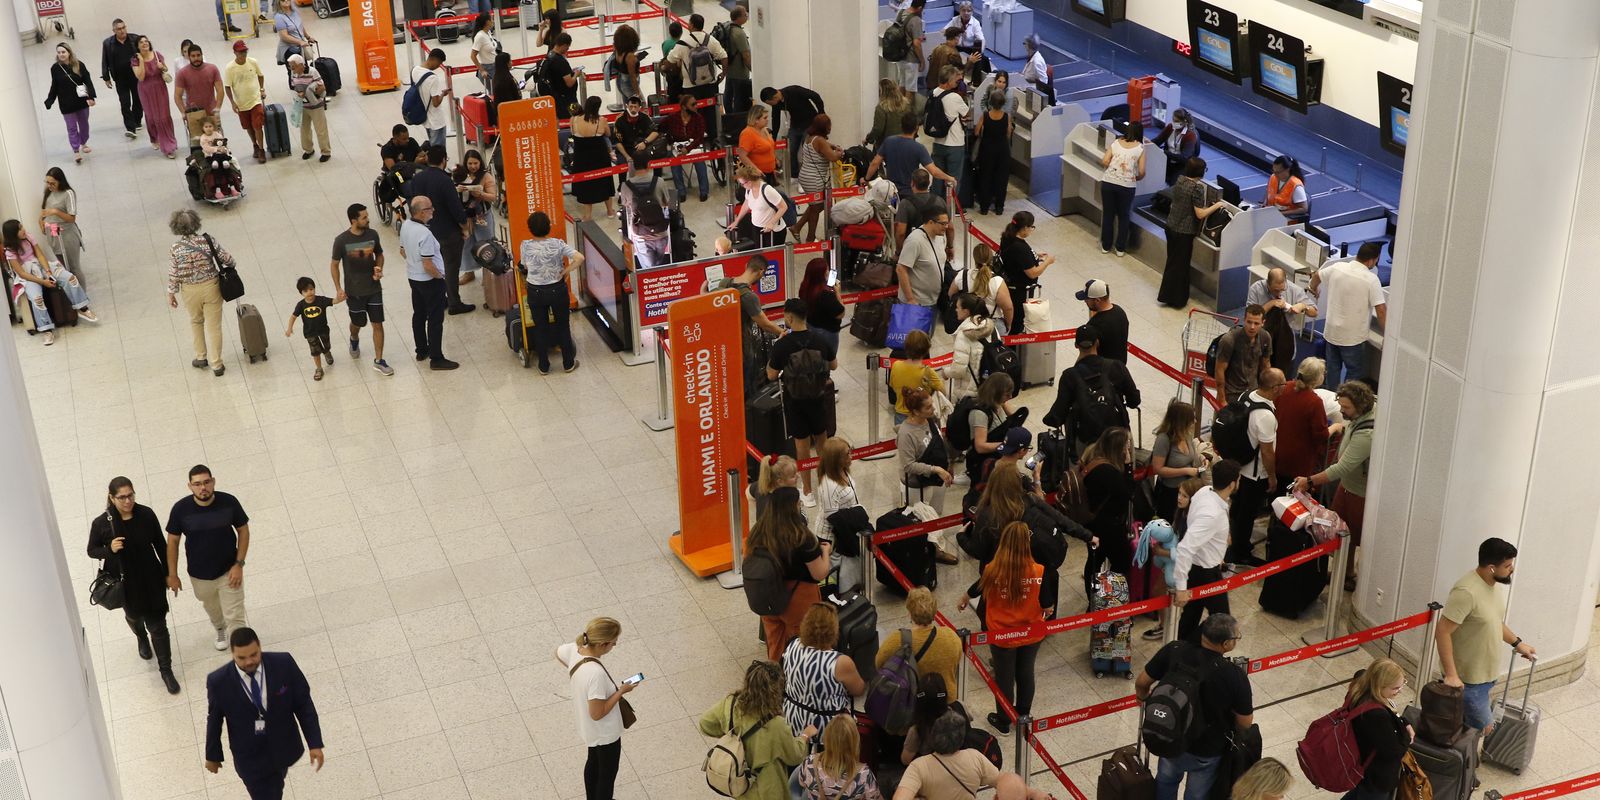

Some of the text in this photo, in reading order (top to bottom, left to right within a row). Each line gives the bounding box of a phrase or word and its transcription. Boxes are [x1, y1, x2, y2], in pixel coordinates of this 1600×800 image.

[361, 0, 375, 26] BAG
[1205, 9, 1219, 27] 23
[1268, 34, 1284, 53] 24
[1401, 88, 1411, 105] 2
[533, 100, 553, 109] GOL
[526, 170, 535, 216] FERENCIAL
[713, 293, 738, 307] GOL
[648, 308, 668, 317] HotM
[683, 353, 696, 403] check-in
[697, 349, 716, 496] MIAMI E ORLANDO
[1200, 584, 1228, 595] HotMilhas
[995, 631, 1028, 640] HotMilhas
[1268, 654, 1299, 666] HotMilhas
[1056, 712, 1088, 724] HotMilhas
